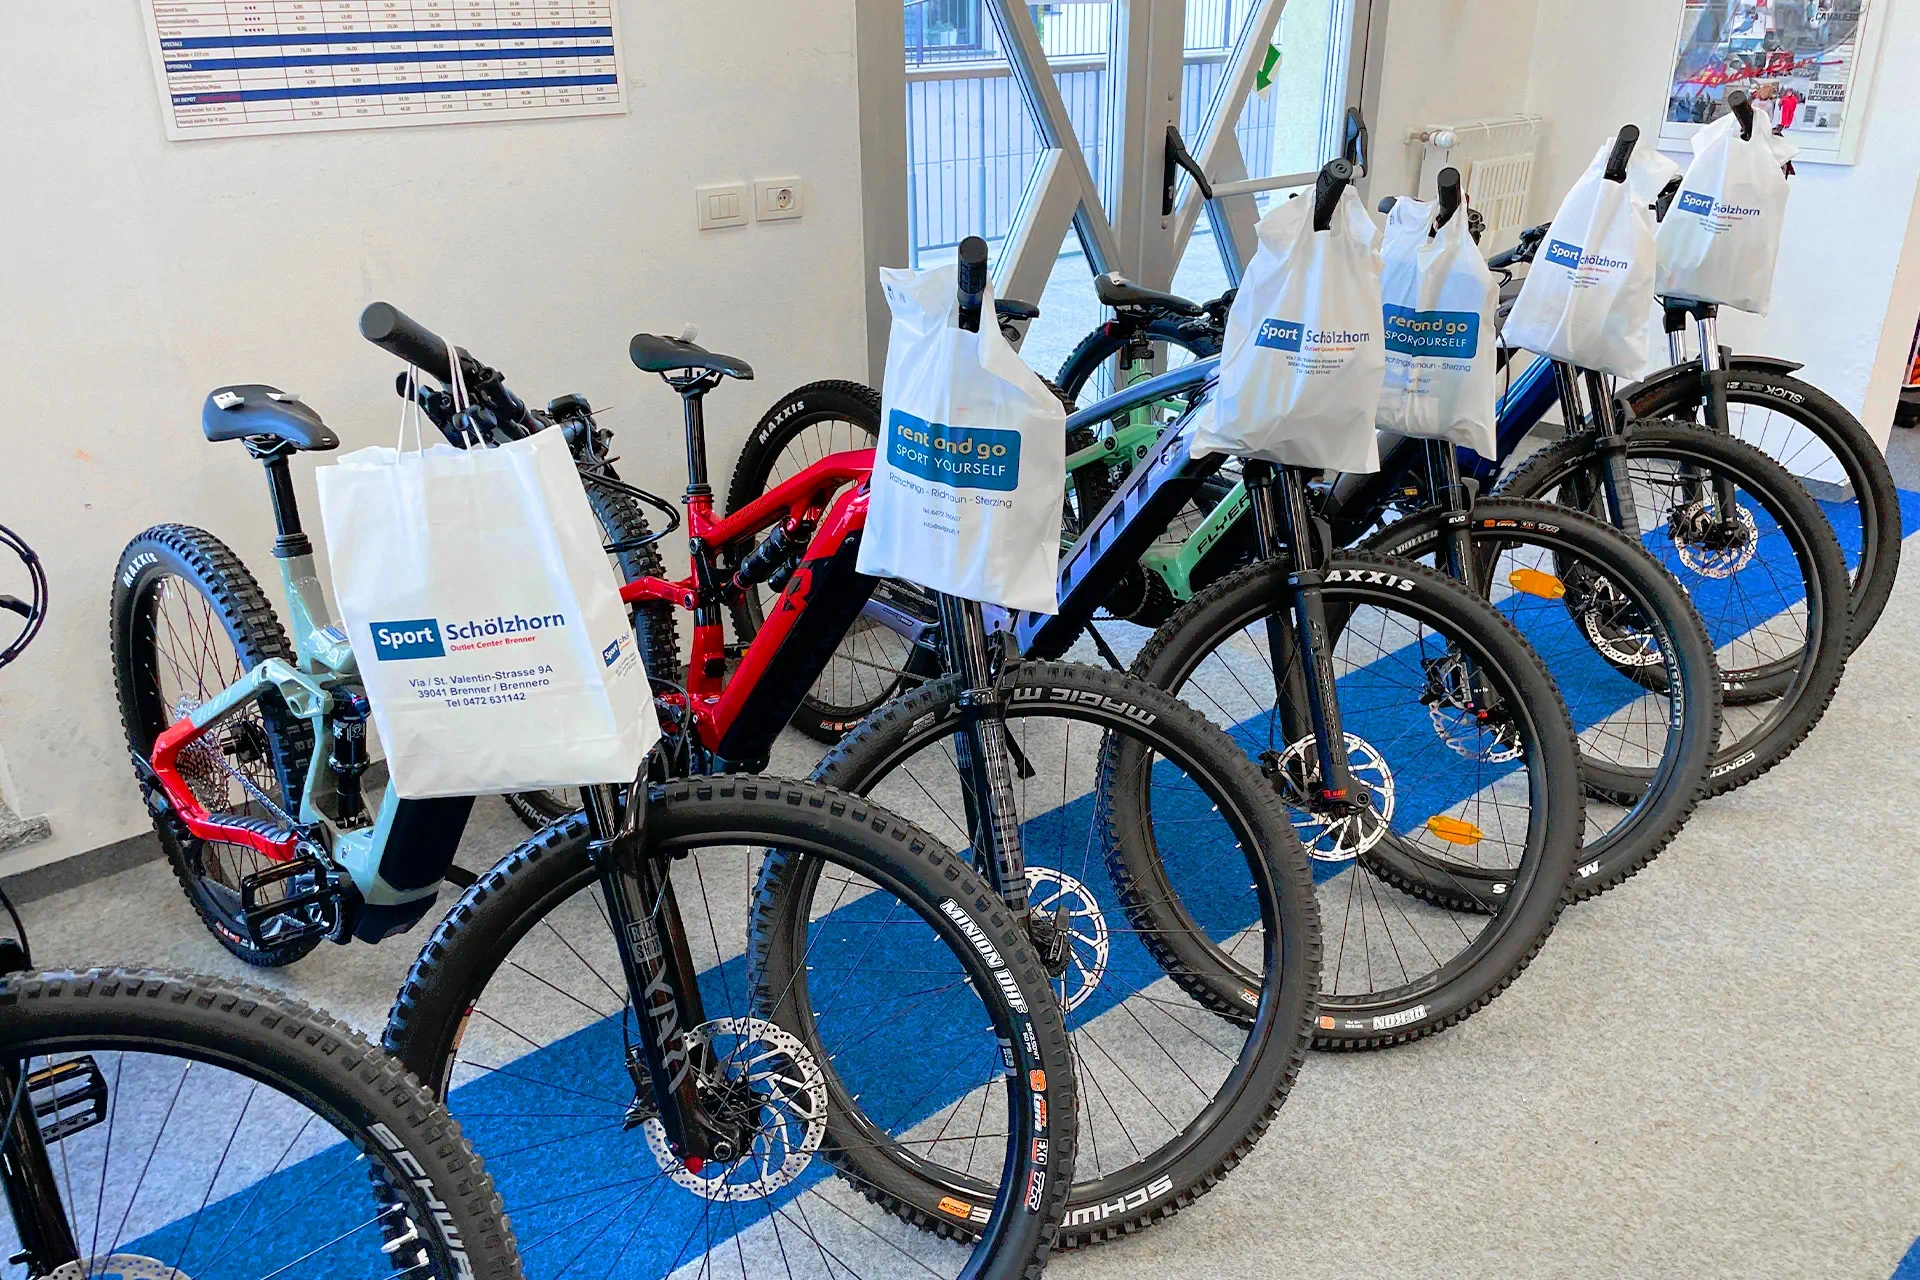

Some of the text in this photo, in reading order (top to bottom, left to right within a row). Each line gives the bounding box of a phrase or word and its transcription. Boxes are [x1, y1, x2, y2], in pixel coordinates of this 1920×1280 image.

[1683, 194, 1710, 208] Sport
[1551, 243, 1579, 260] Sport
[1260, 323, 1370, 345] Sport Schölzhorn
[1445, 322, 1468, 335] go
[1412, 334, 1467, 348] YOURSELF
[758, 401, 805, 445] MAXXIS
[896, 424, 1007, 460] rent and go
[896, 444, 1006, 477] SPORT YOURSELF
[975, 495, 1012, 509] Sterzing
[122, 552, 158, 588] MAXXIS
[1324, 569, 1416, 592] AXXIS
[377, 612, 565, 650] Sport Schölzhorn
[450, 635, 536, 652] Outlet Center Brenner
[409, 677, 427, 688] Via
[434, 675, 448, 686] St.
[450, 669, 535, 685] Valentin-Strasse
[538, 665, 553, 675] 9A
[418, 688, 447, 699] 39041
[450, 685, 491, 696] Brenner
[500, 678, 550, 692] Brennero
[446, 692, 526, 708] Tel 0472 631142
[1049, 688, 1156, 726] MAGIC
[939, 897, 1029, 1014] MINION DHF
[1372, 1004, 1428, 1031] REKON
[1035, 1139, 1048, 1164] EXO
[1028, 1171, 1046, 1211] TR
